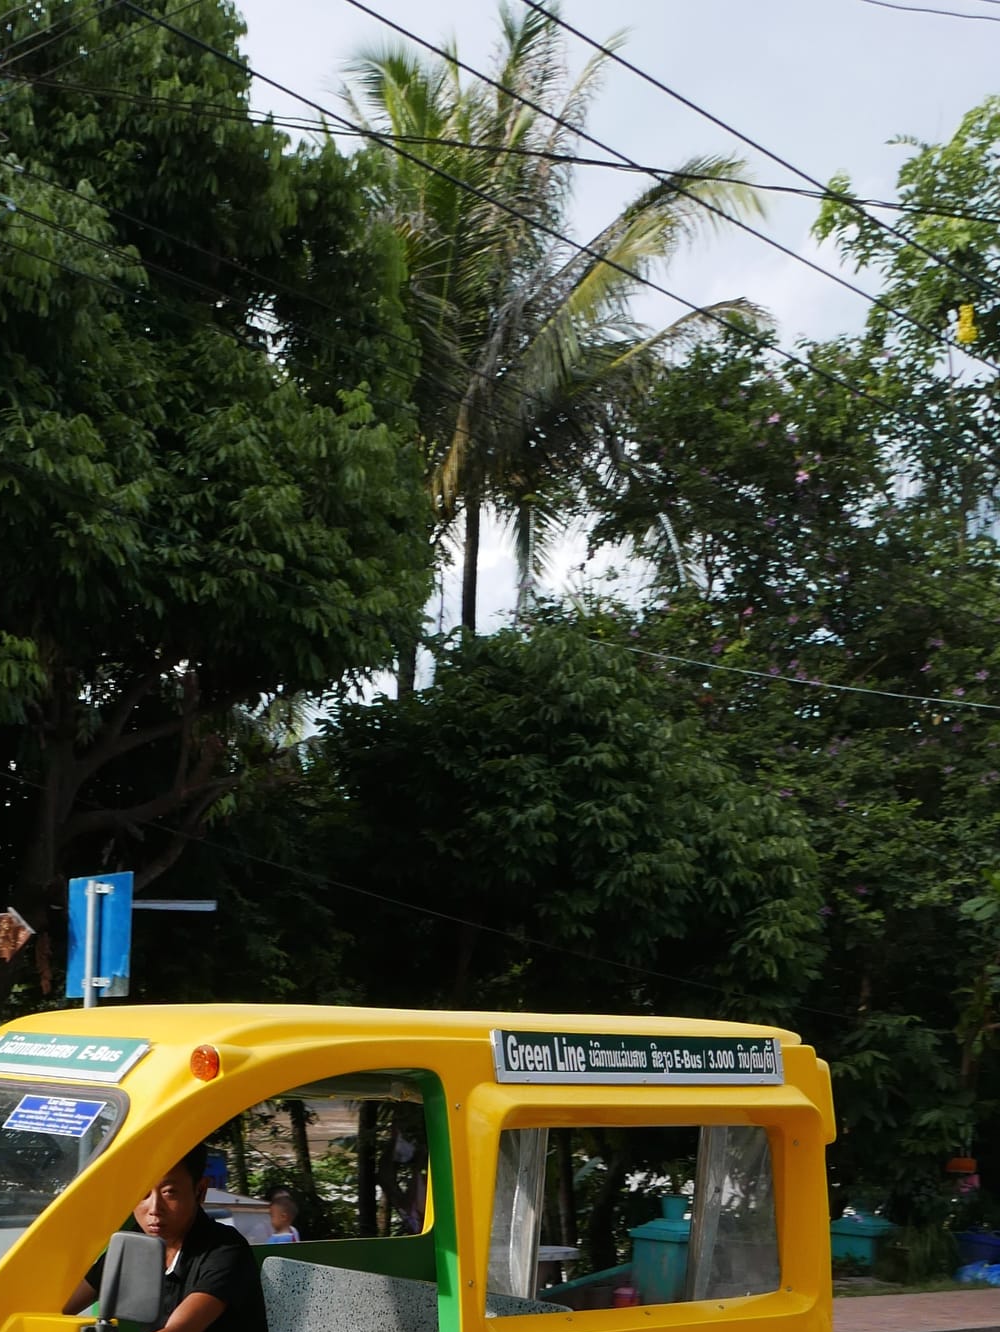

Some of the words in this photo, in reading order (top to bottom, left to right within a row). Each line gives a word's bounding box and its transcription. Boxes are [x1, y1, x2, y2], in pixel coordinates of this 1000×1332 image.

[76, 1045, 124, 1062] E-Bus
[506, 1034, 552, 1071] Green
[553, 1036, 586, 1072] Line
[673, 1049, 703, 1069] E-Bus
[707, 1049, 735, 1069] 3.000
